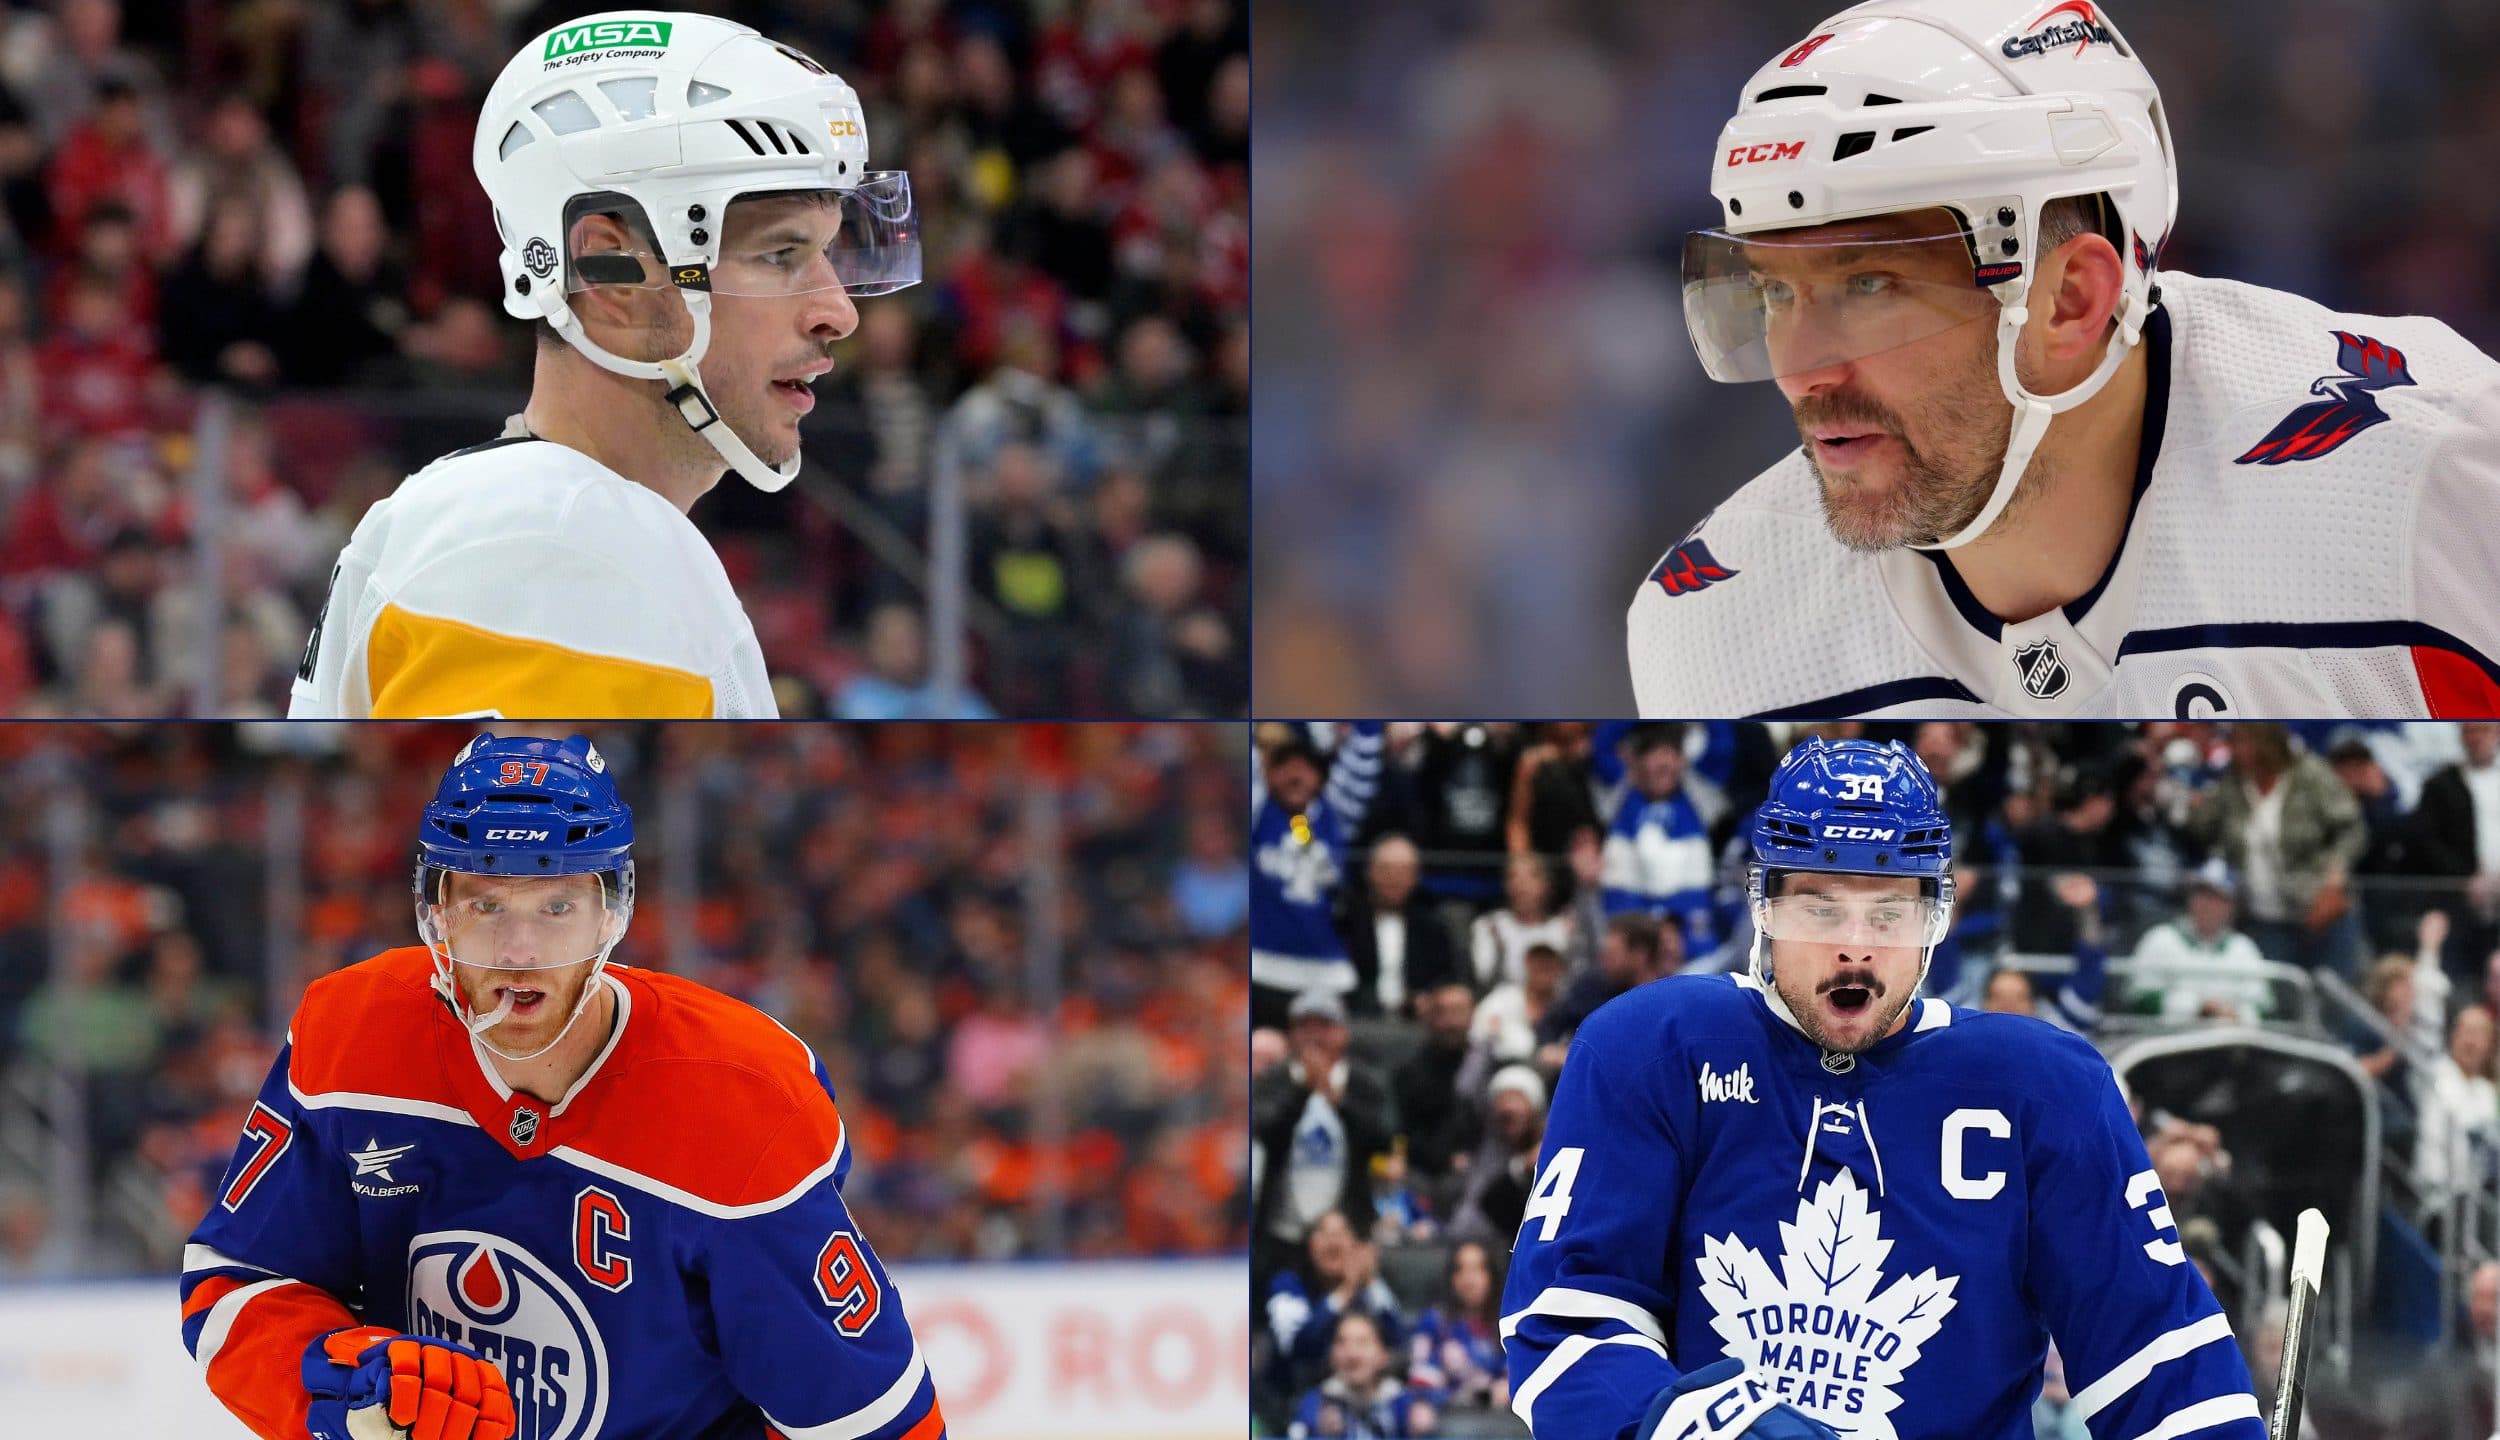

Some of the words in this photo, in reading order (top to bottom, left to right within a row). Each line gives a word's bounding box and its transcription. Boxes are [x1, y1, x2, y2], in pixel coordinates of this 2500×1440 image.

[549, 22, 663, 56] MSA
[1780, 33, 1836, 68] 8
[544, 60, 563, 73] The
[565, 51, 604, 67] Safety
[606, 48, 666, 60] Company
[829, 120, 861, 137] CC
[1727, 140, 1806, 168] CCM
[2030, 653, 2055, 692] NHL
[500, 761, 550, 787] 97
[1836, 774, 1884, 802] 34
[485, 829, 550, 842] CCM
[1822, 825, 1897, 841] CCM
[1828, 1052, 1849, 1067] NHL
[1698, 1061, 1760, 1104] Milk
[515, 1120, 535, 1136] NHL
[219, 1100, 294, 1214] 7
[1941, 1108, 2012, 1200] C
[1511, 1147, 1586, 1252] 4
[572, 1184, 633, 1294] C
[813, 1230, 894, 1338] 9
[1736, 1302, 1902, 1362] TORONTO
[1048, 1302, 1248, 1413] RO
[1759, 1339, 1872, 1382] MAPLE
[1774, 1375, 1865, 1414] EAFS
